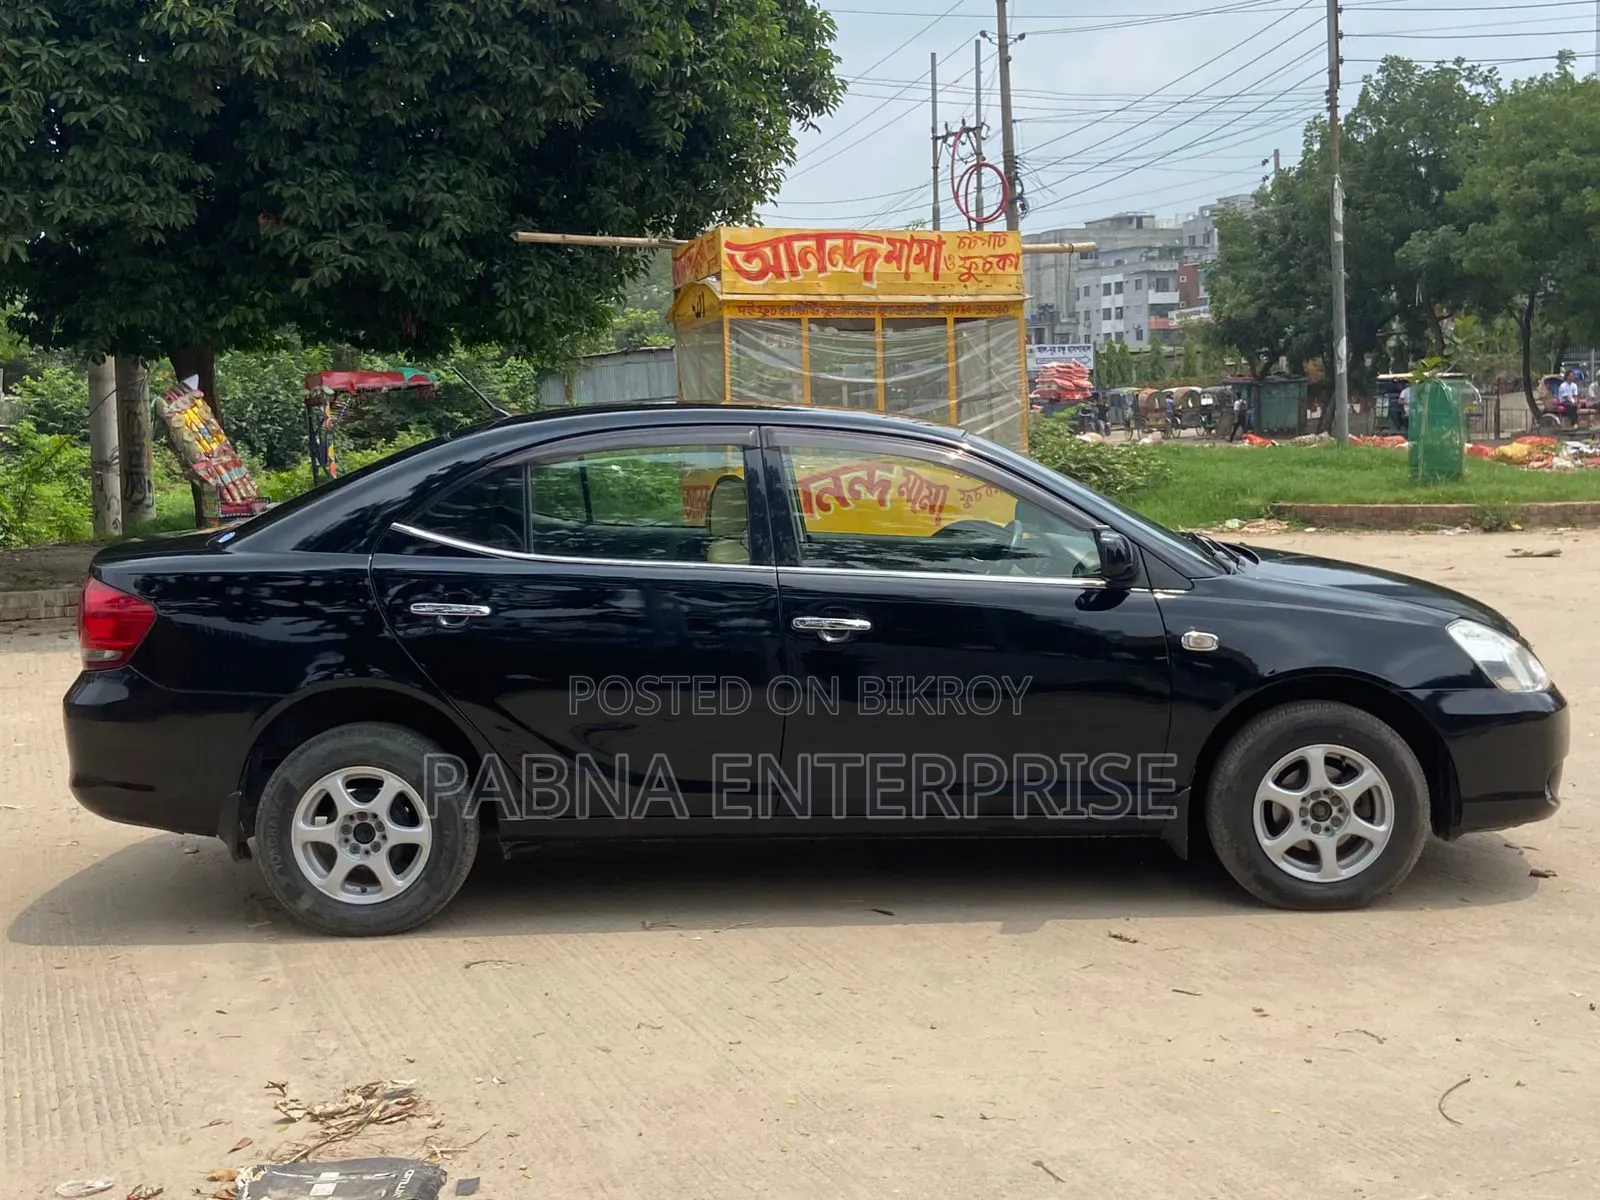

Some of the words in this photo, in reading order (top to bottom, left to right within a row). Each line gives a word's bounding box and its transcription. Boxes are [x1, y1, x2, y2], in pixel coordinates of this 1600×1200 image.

[724, 232, 884, 284] আনন্দ
[884, 233, 946, 282] মামা
[958, 252, 1020, 283] ফুচকা
